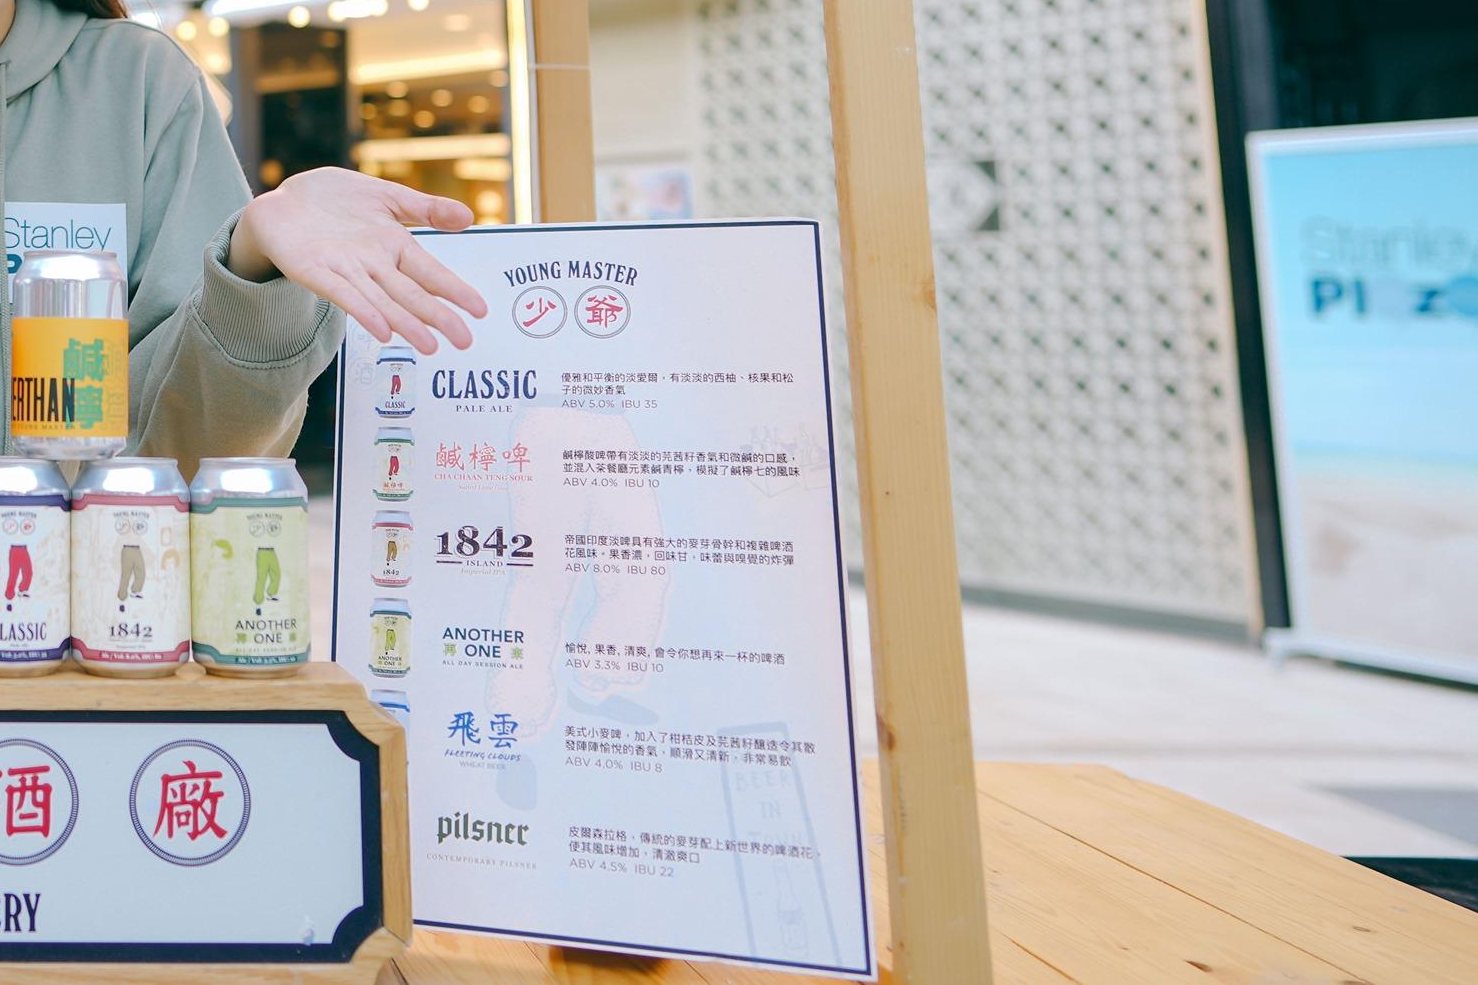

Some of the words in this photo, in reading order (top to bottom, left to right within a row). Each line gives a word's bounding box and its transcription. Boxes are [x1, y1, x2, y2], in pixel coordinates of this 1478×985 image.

[4, 217, 112, 251] Stanley
[503, 261, 562, 288] YOUNG
[567, 260, 639, 287] MASTER
[432, 369, 537, 400] CLASSIC
[456, 405, 486, 413] PALE
[490, 405, 513, 413] ALE
[561, 399, 585, 408] ABV
[589, 399, 615, 408] 5.0%
[621, 399, 641, 408] IBU
[644, 399, 658, 408] 35
[434, 441, 531, 472] 鹹檸啤
[563, 478, 588, 487] ABV
[591, 478, 618, 487] 4.0%
[625, 478, 644, 488] IBU
[648, 479, 660, 488] 10
[434, 525, 534, 558] 1842
[565, 563, 589, 573] ABV
[593, 564, 620, 574] 8.0%
[627, 564, 647, 574] IBU
[650, 565, 666, 575] 80
[109, 622, 153, 638] 1842
[235, 618, 297, 631] ANOTHER
[254, 633, 283, 644] ONE
[442, 627, 524, 644] ANOTHER
[464, 644, 502, 658] ONE
[565, 660, 590, 669] ABV
[594, 661, 621, 671] 3.3%
[627, 662, 648, 672] IBU
[652, 663, 664, 673] 10
[447, 711, 519, 749] 飛雲
[565, 756, 591, 767] ABV
[594, 758, 624, 770] 4.0%
[630, 760, 652, 772] IBU
[654, 762, 663, 773] 8
[437, 811, 530, 847] pilsner
[570, 857, 595, 869] ABV
[599, 859, 628, 873] 4.5%
[634, 864, 656, 876] IBU
[660, 867, 674, 878] 22
